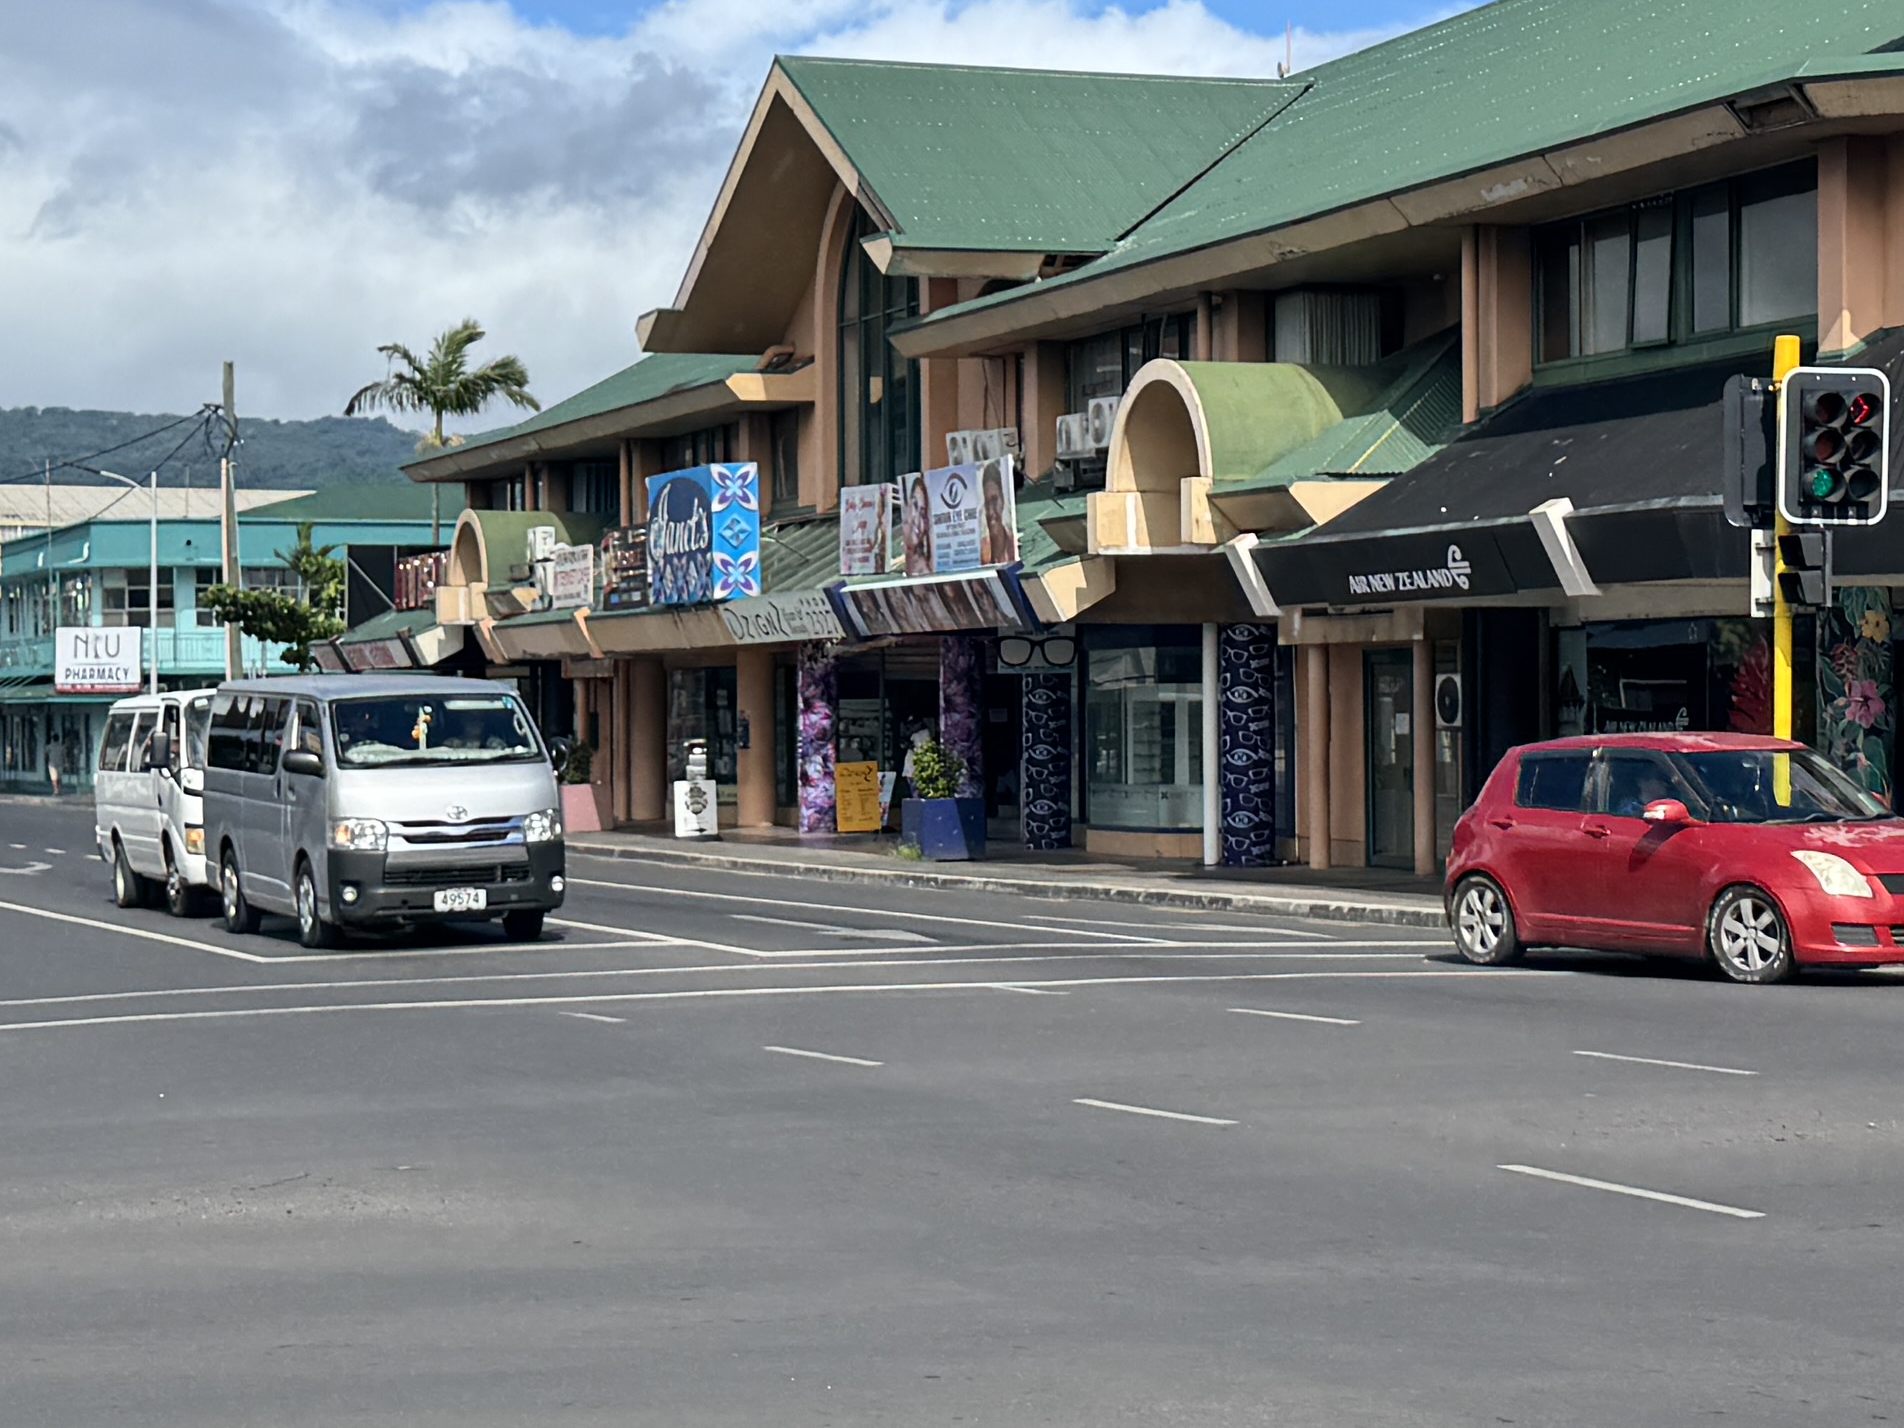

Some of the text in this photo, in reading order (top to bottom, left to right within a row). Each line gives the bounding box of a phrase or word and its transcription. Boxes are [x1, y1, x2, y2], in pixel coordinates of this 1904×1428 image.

[1348, 568, 1453, 594] AIR NEW ZEALAND
[64, 666, 129, 681] PHARMACY
[442, 891, 480, 906] 49574
